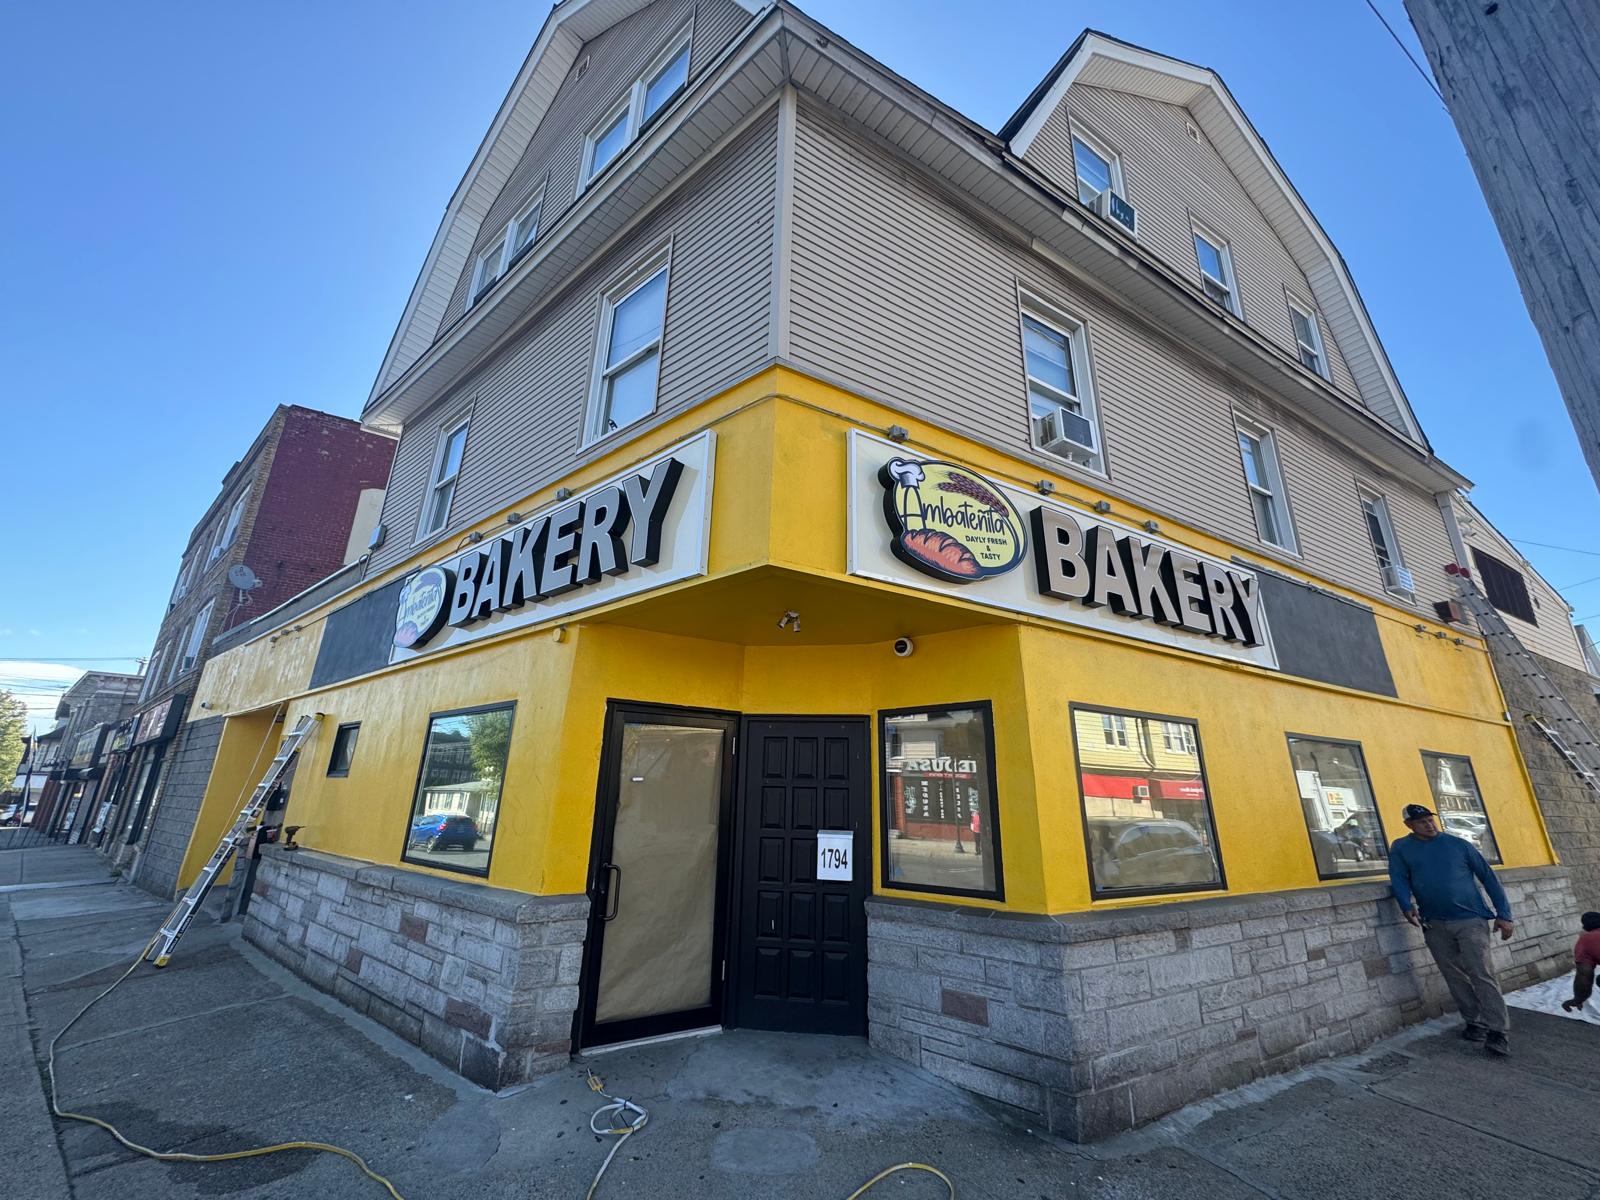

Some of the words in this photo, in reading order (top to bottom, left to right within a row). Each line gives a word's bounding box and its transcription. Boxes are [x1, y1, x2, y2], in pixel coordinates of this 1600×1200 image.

[900, 486, 1005, 535] Ambateñita
[448, 457, 684, 629] BAKERY
[965, 535, 986, 544] DAYLY
[987, 537, 1007, 546] FRESH
[980, 552, 1001, 561] TASTY
[1032, 506, 1265, 648] BAKERY
[821, 848, 848, 870] 1794
